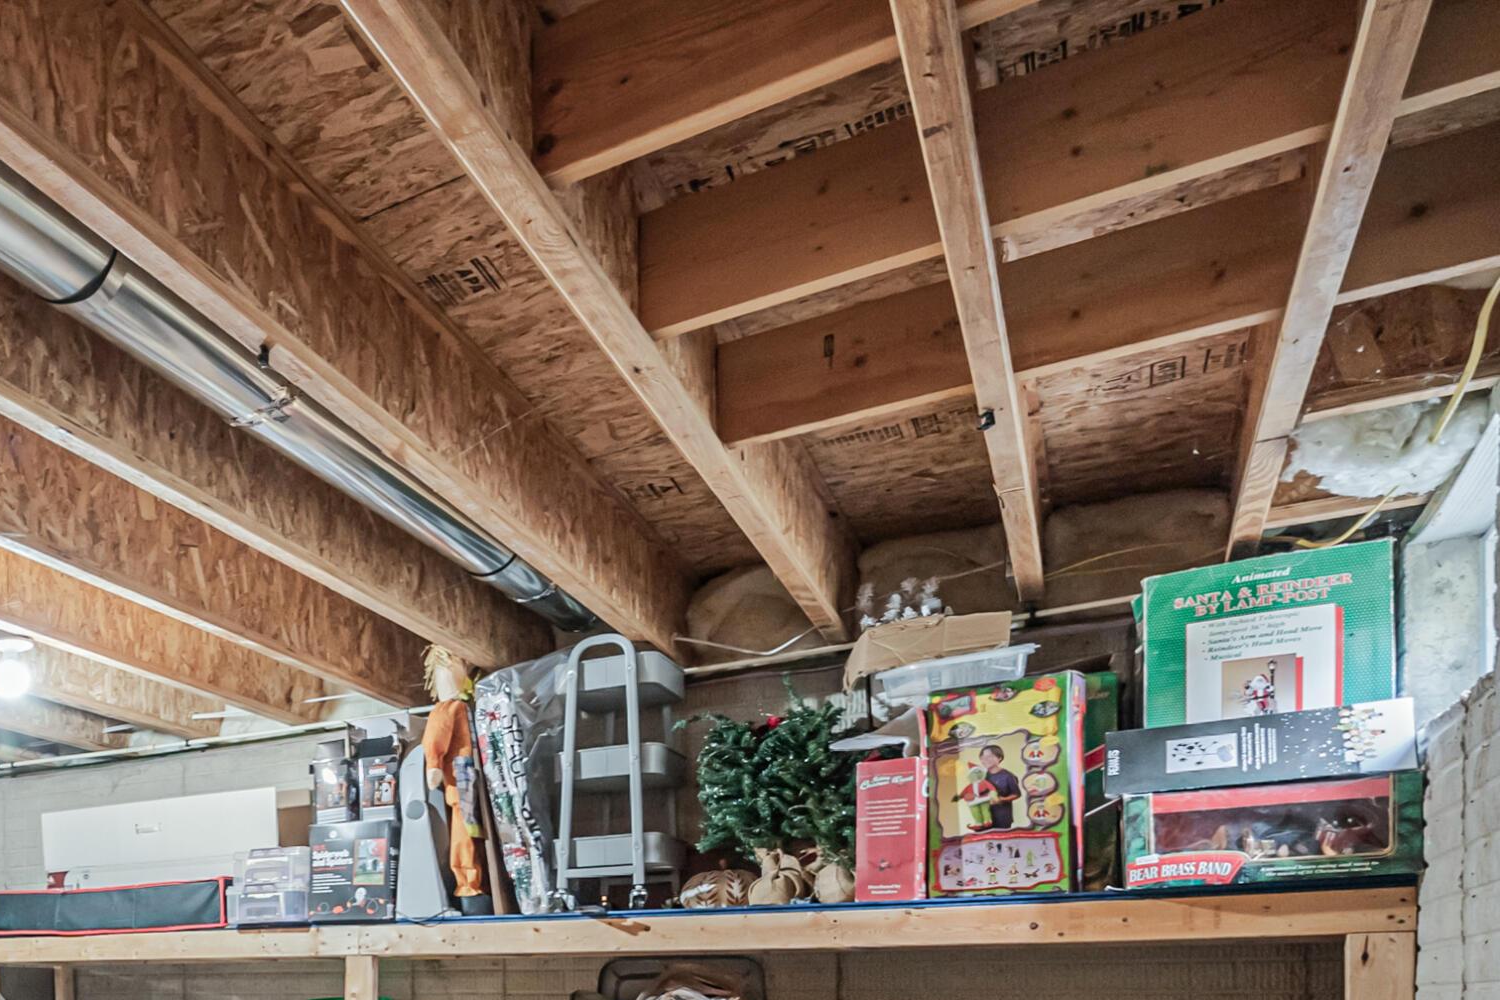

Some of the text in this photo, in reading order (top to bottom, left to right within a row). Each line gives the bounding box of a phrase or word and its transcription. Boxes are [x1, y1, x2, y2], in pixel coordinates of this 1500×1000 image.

[1231, 567, 1292, 584] Animated
[1173, 572, 1353, 610] SANTA & REINDEER
[1195, 587, 1331, 617] BY LAMP-POST
[1129, 860, 1232, 883] BEAR BRASS BAND
